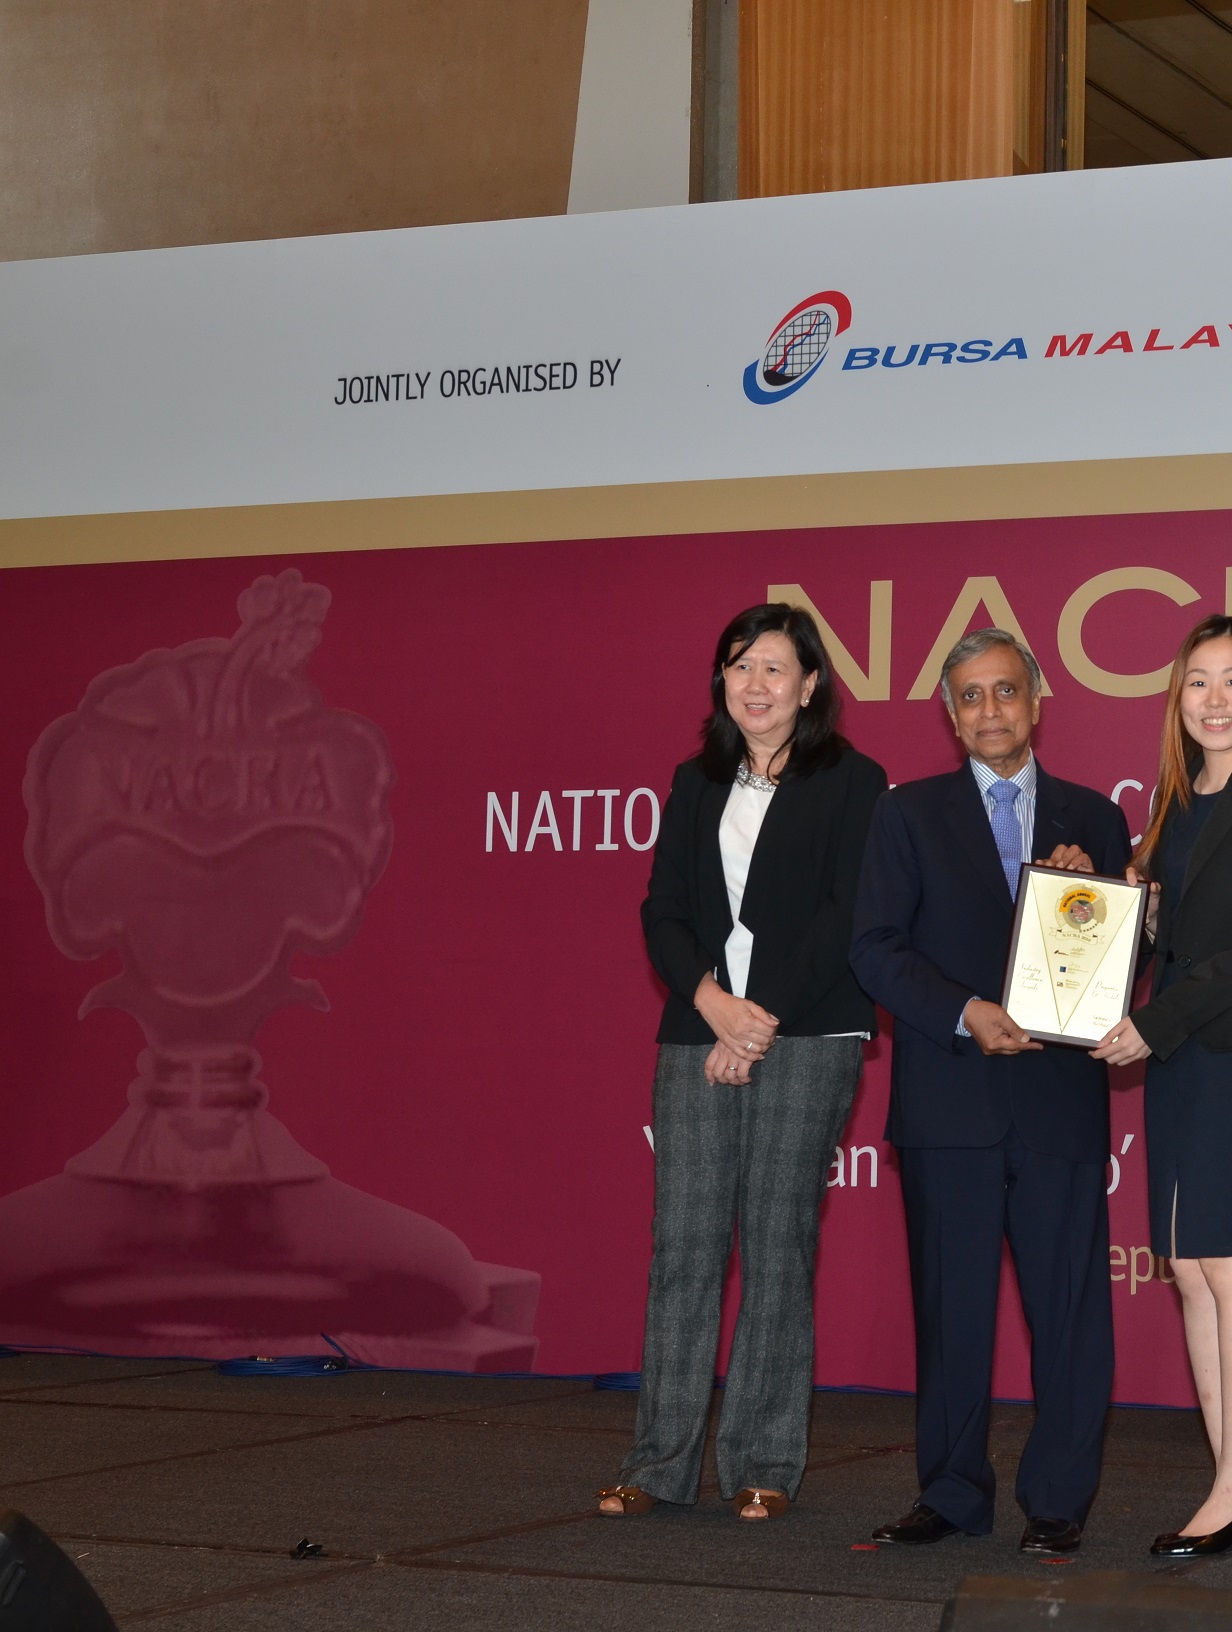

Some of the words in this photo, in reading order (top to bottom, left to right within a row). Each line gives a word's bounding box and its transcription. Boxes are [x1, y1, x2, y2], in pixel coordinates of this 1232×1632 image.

[841, 337, 1029, 371] BURSA
[333, 371, 431, 406] JOINTLY
[439, 361, 578, 398] ORGANISED
[589, 358, 622, 388] BY
[485, 787, 672, 852] NATIO
